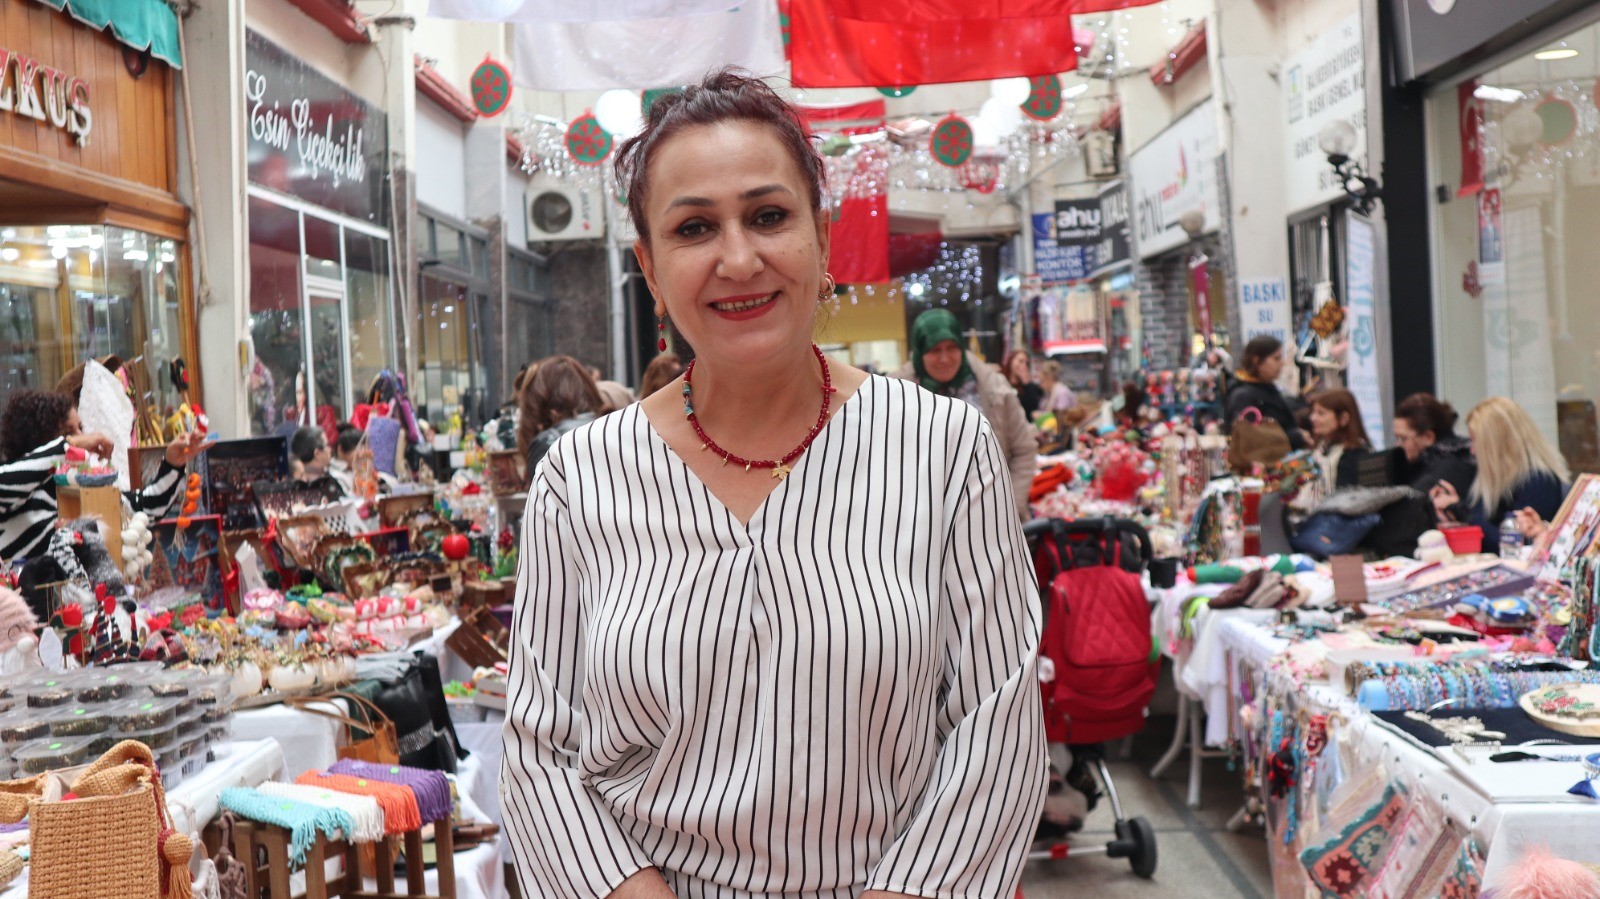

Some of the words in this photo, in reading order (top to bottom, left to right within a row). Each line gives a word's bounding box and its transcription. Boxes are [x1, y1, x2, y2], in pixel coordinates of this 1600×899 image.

[246, 69, 291, 151] Esin
[1058, 206, 1100, 228] ahu
[1242, 278, 1286, 304] BASKİ
[1257, 308, 1274, 323] SU
